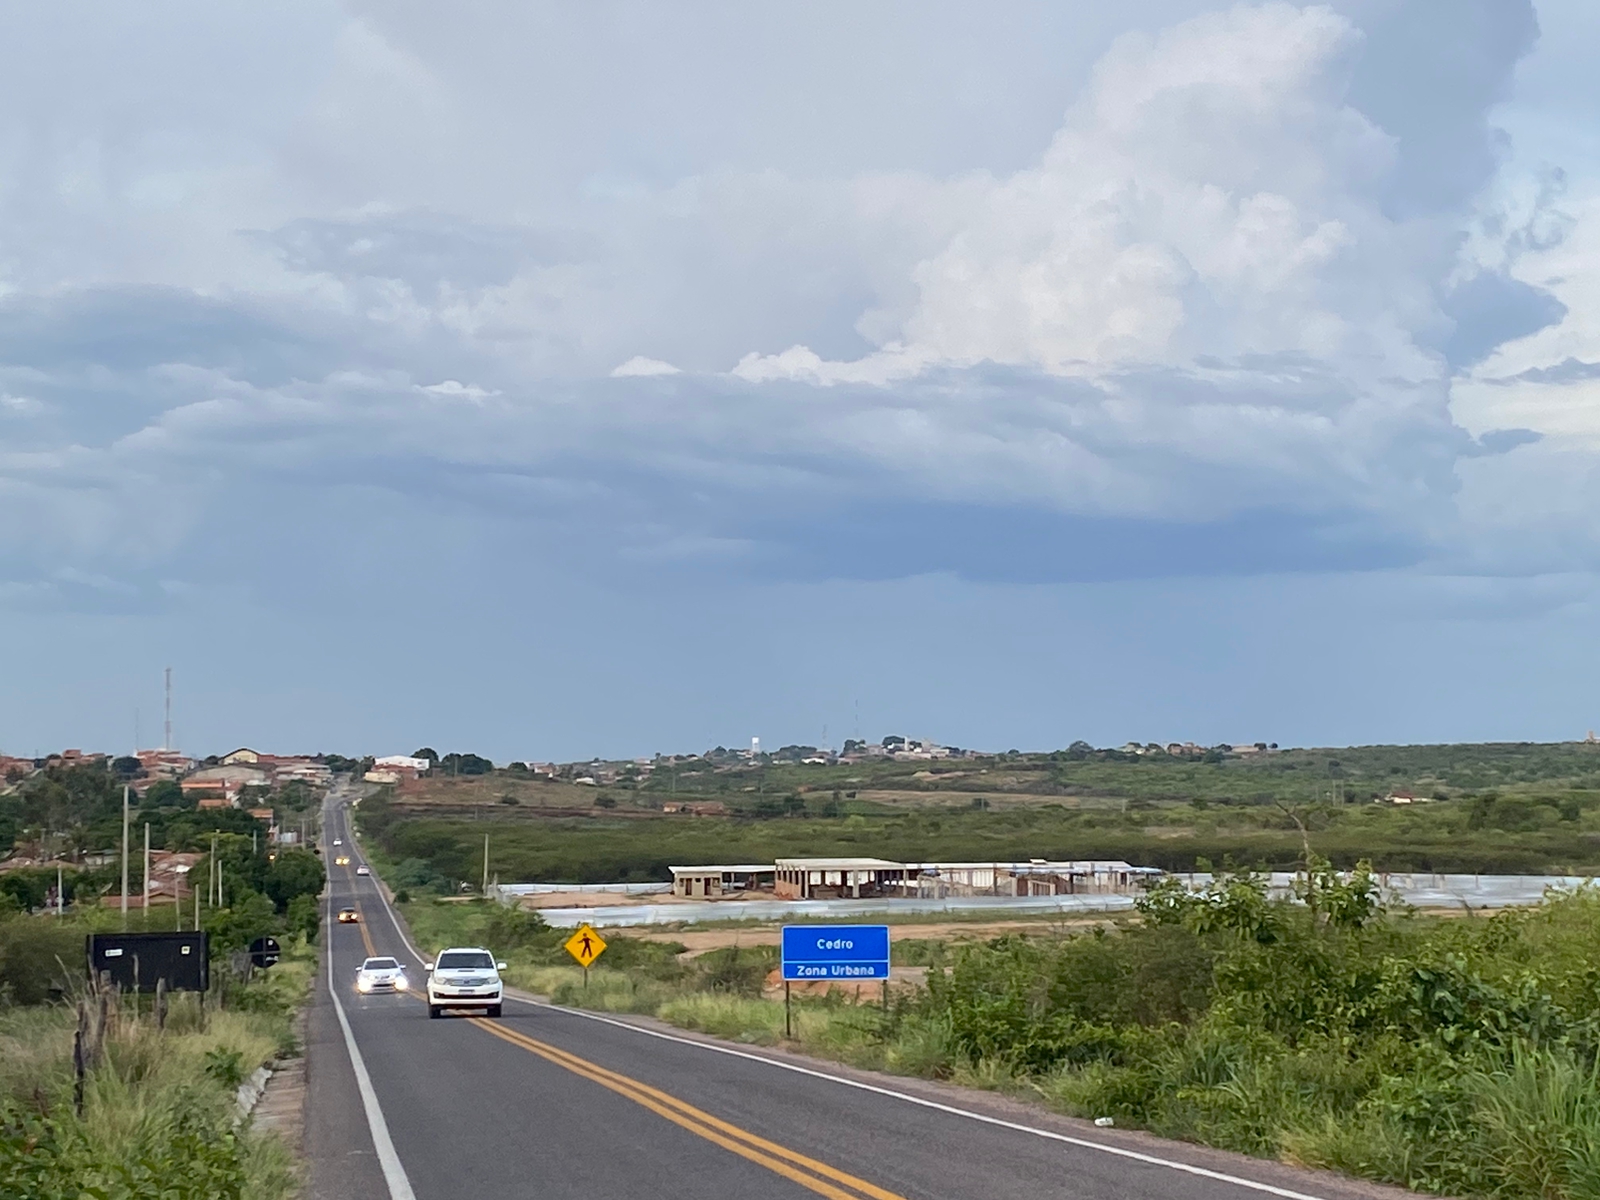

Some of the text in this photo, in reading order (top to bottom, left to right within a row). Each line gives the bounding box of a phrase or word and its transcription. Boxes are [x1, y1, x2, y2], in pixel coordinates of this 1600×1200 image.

[817, 938, 853, 949] Cedro
[797, 965, 875, 975] Zona Urbana
